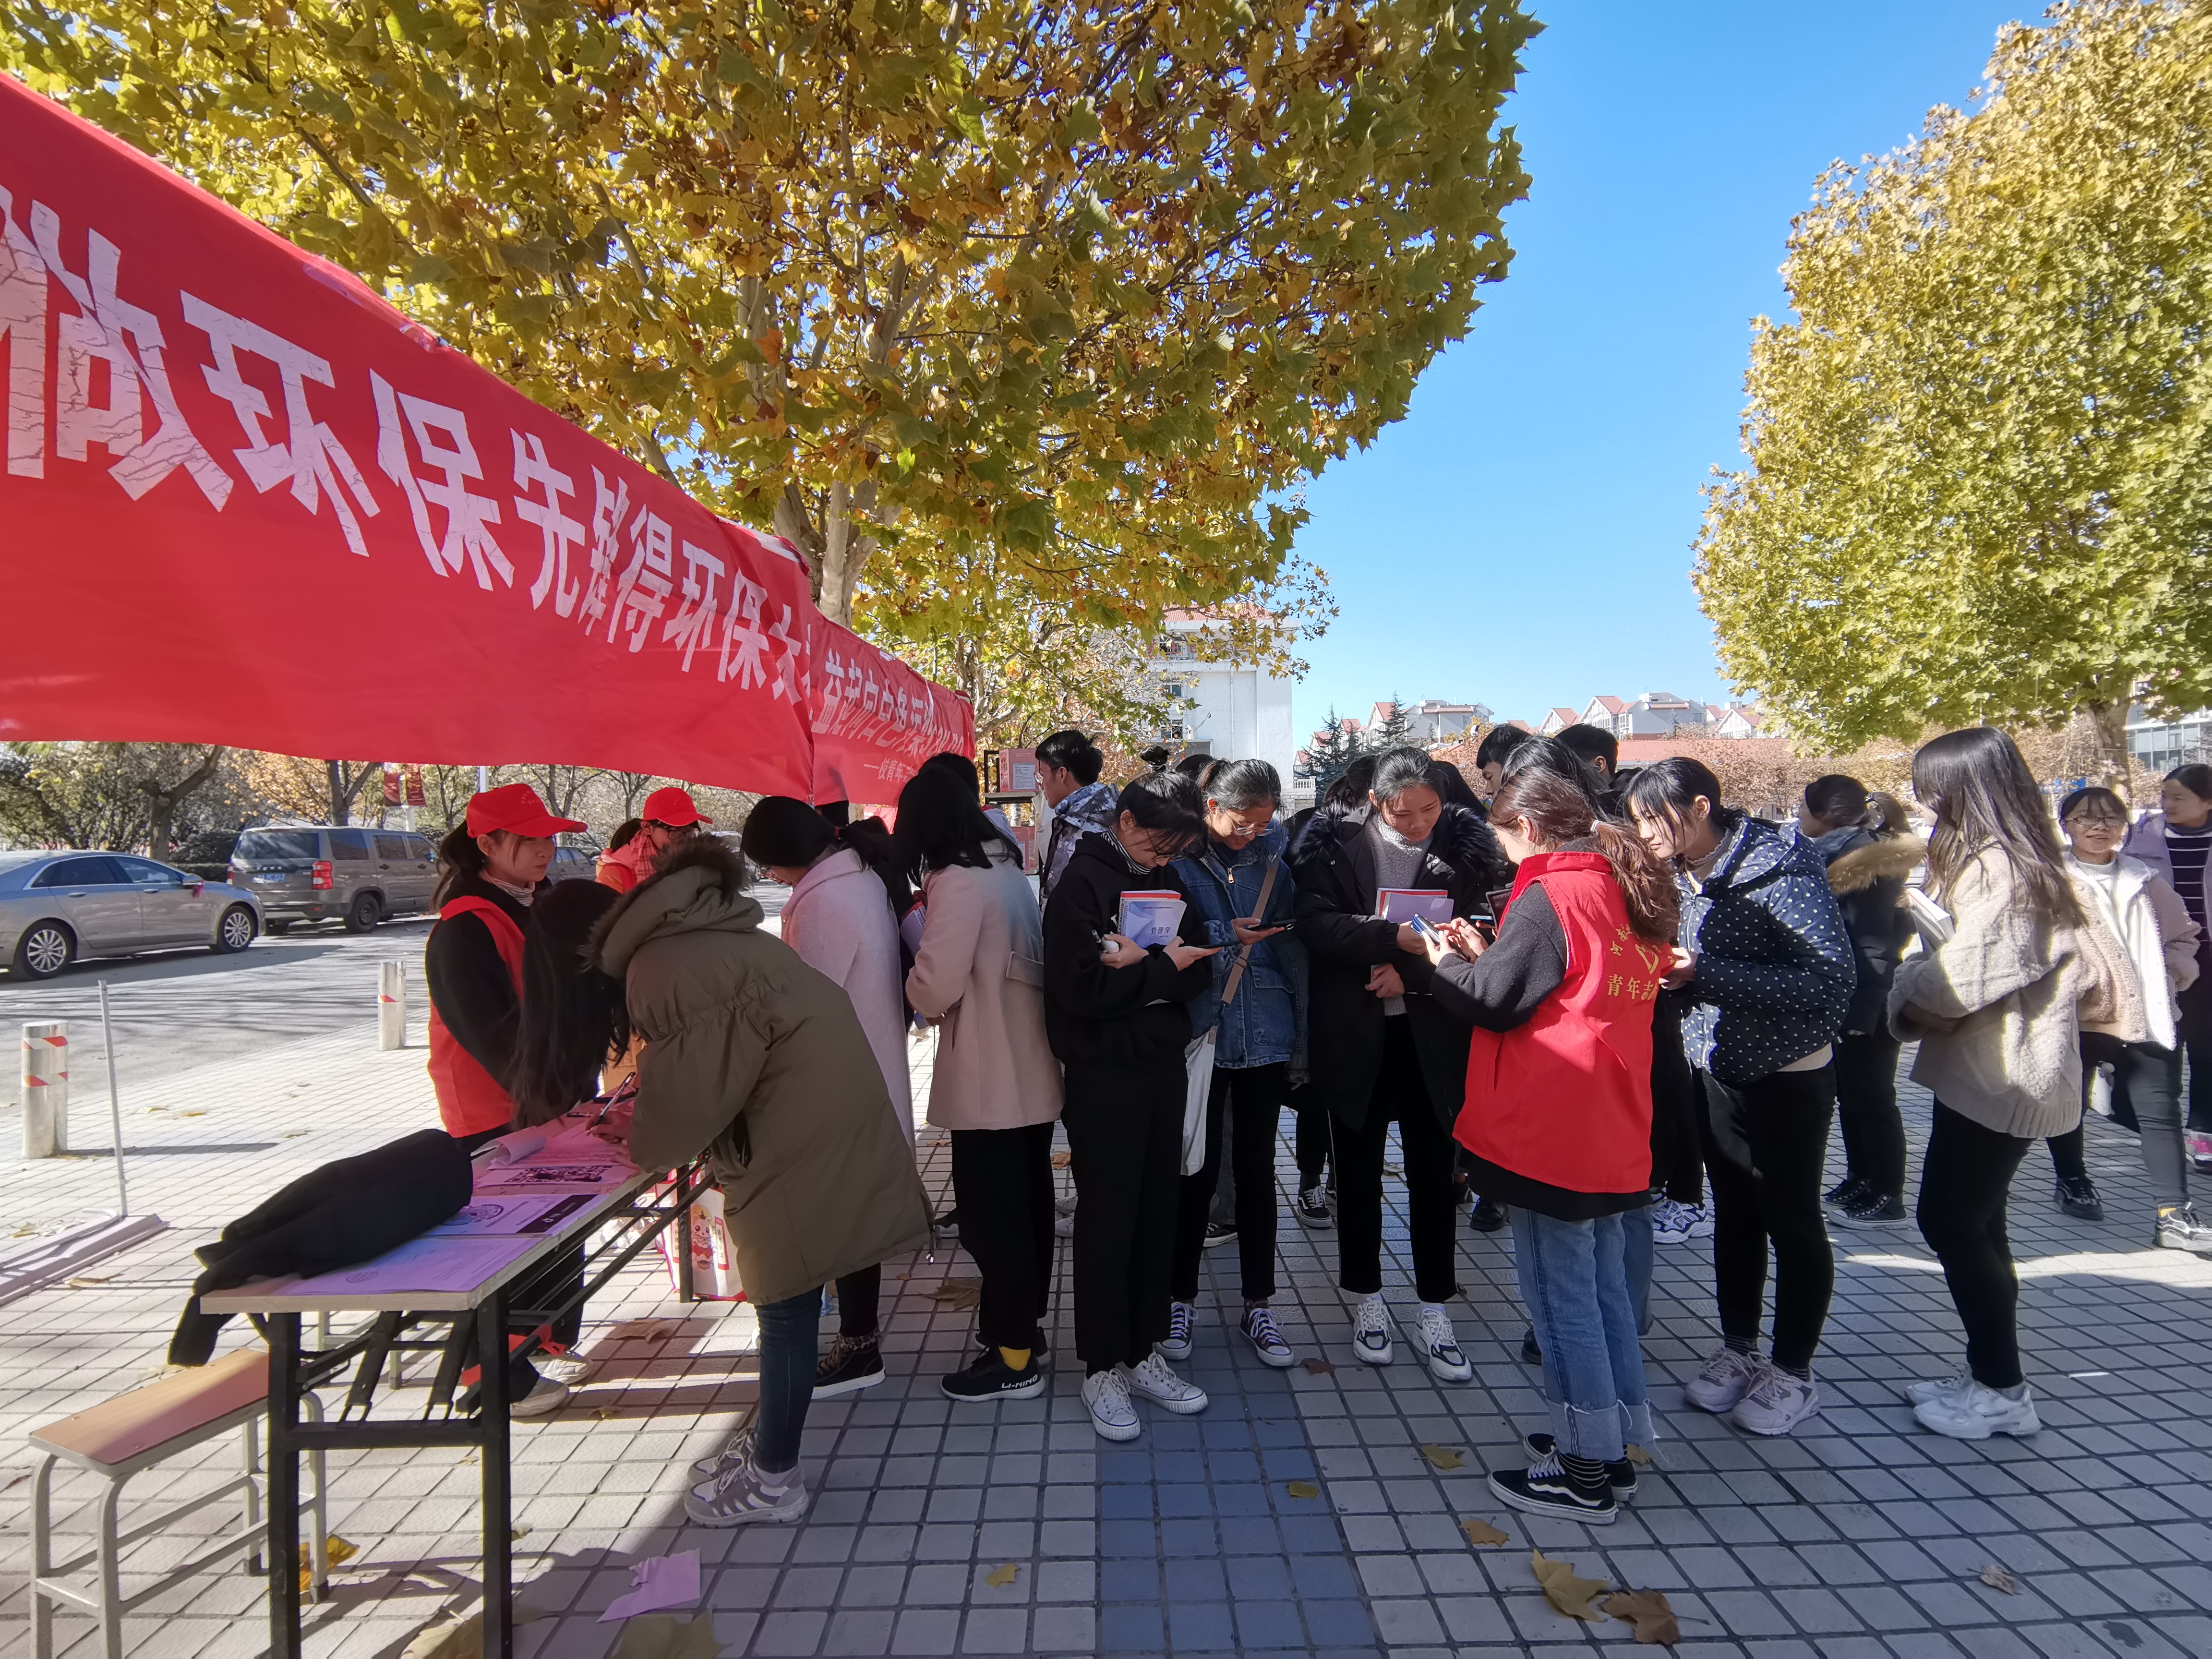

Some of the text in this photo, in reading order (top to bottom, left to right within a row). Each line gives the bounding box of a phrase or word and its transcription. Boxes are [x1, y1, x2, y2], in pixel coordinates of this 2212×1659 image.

[1151, 926, 1171, 935] 管理学
[1001, 1373, 1039, 1389] LI-NING
